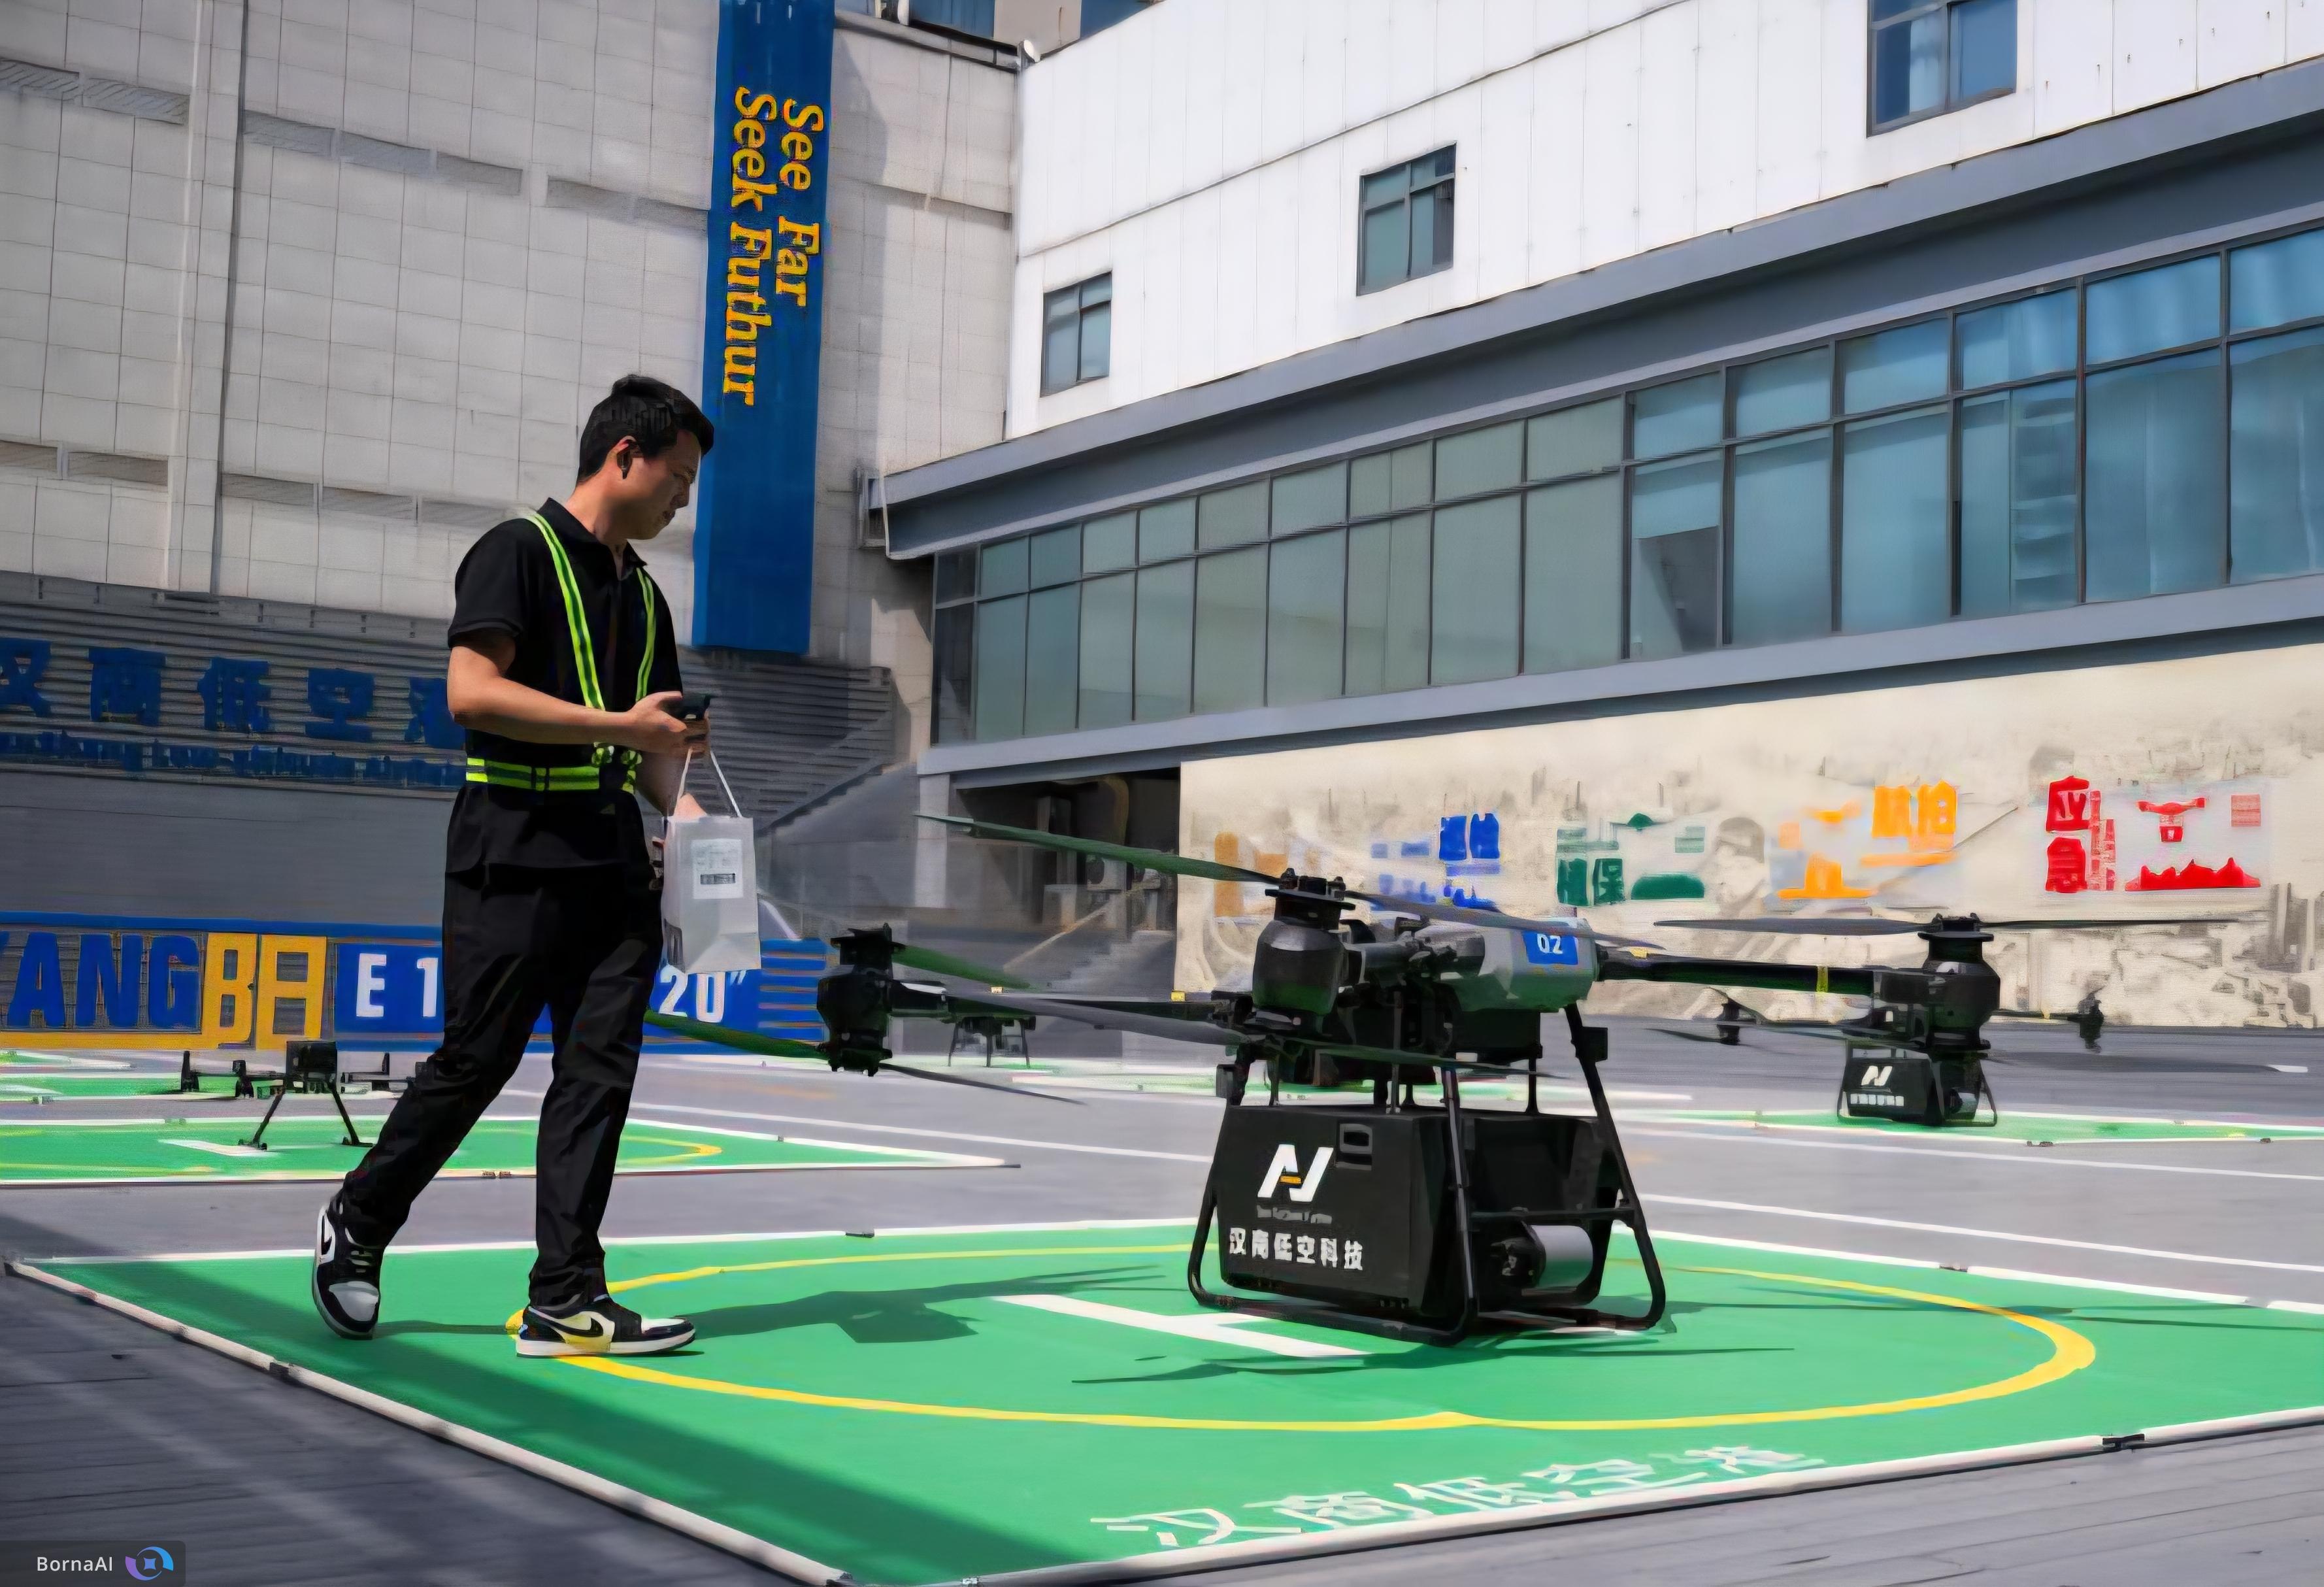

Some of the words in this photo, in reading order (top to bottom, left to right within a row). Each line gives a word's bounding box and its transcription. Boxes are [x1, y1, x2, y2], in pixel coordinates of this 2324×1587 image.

[731, 86, 778, 212] Seek
[780, 98, 824, 191] See
[775, 216, 820, 307] Far
[723, 221, 772, 406] Futhur
[0, 931, 200, 1029] ANG
[356, 952, 387, 1017] E
[1536, 933, 1563, 954] 02
